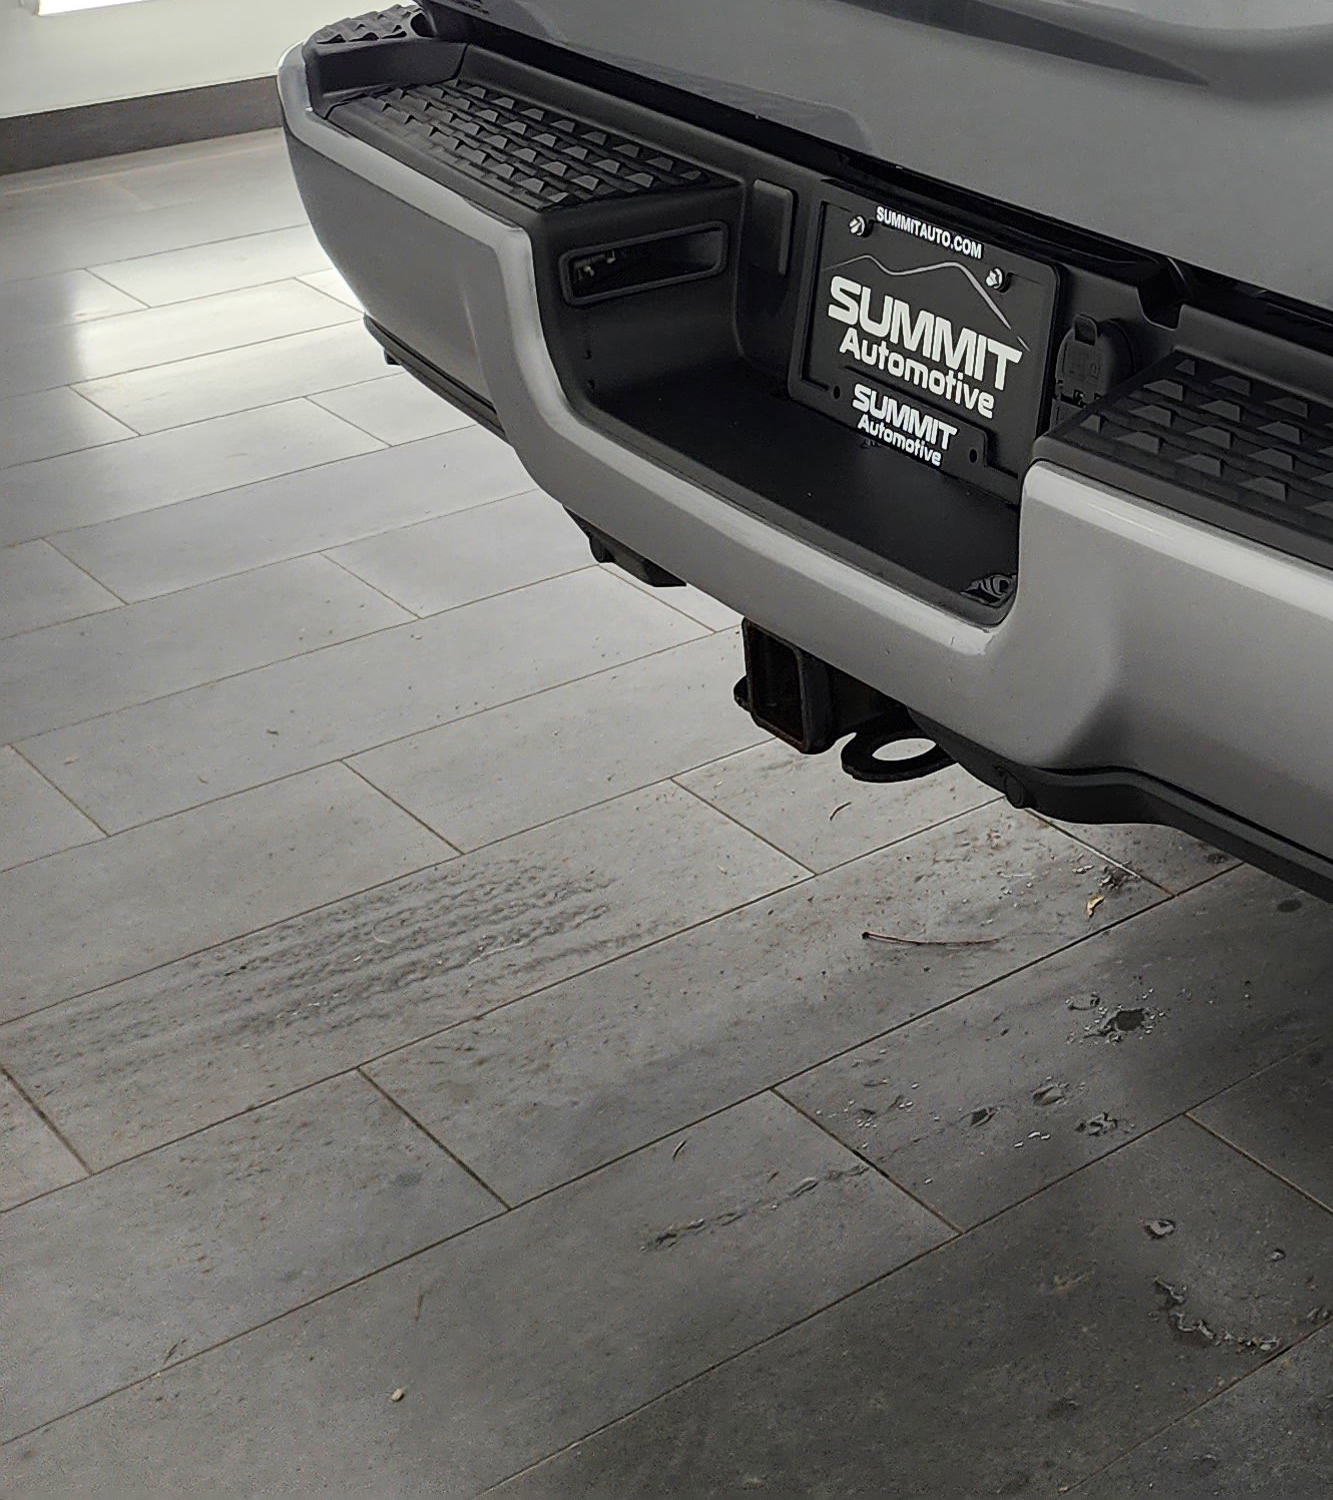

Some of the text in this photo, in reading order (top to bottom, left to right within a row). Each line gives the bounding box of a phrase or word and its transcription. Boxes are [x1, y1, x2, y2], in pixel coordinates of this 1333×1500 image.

[876, 205, 982, 260] SUMMITAUTO.COM
[827, 275, 1023, 391] SUMMIT
[839, 326, 995, 420] Automotive
[851, 382, 958, 451] SUMMIT
[856, 413, 942, 468] Automotive
